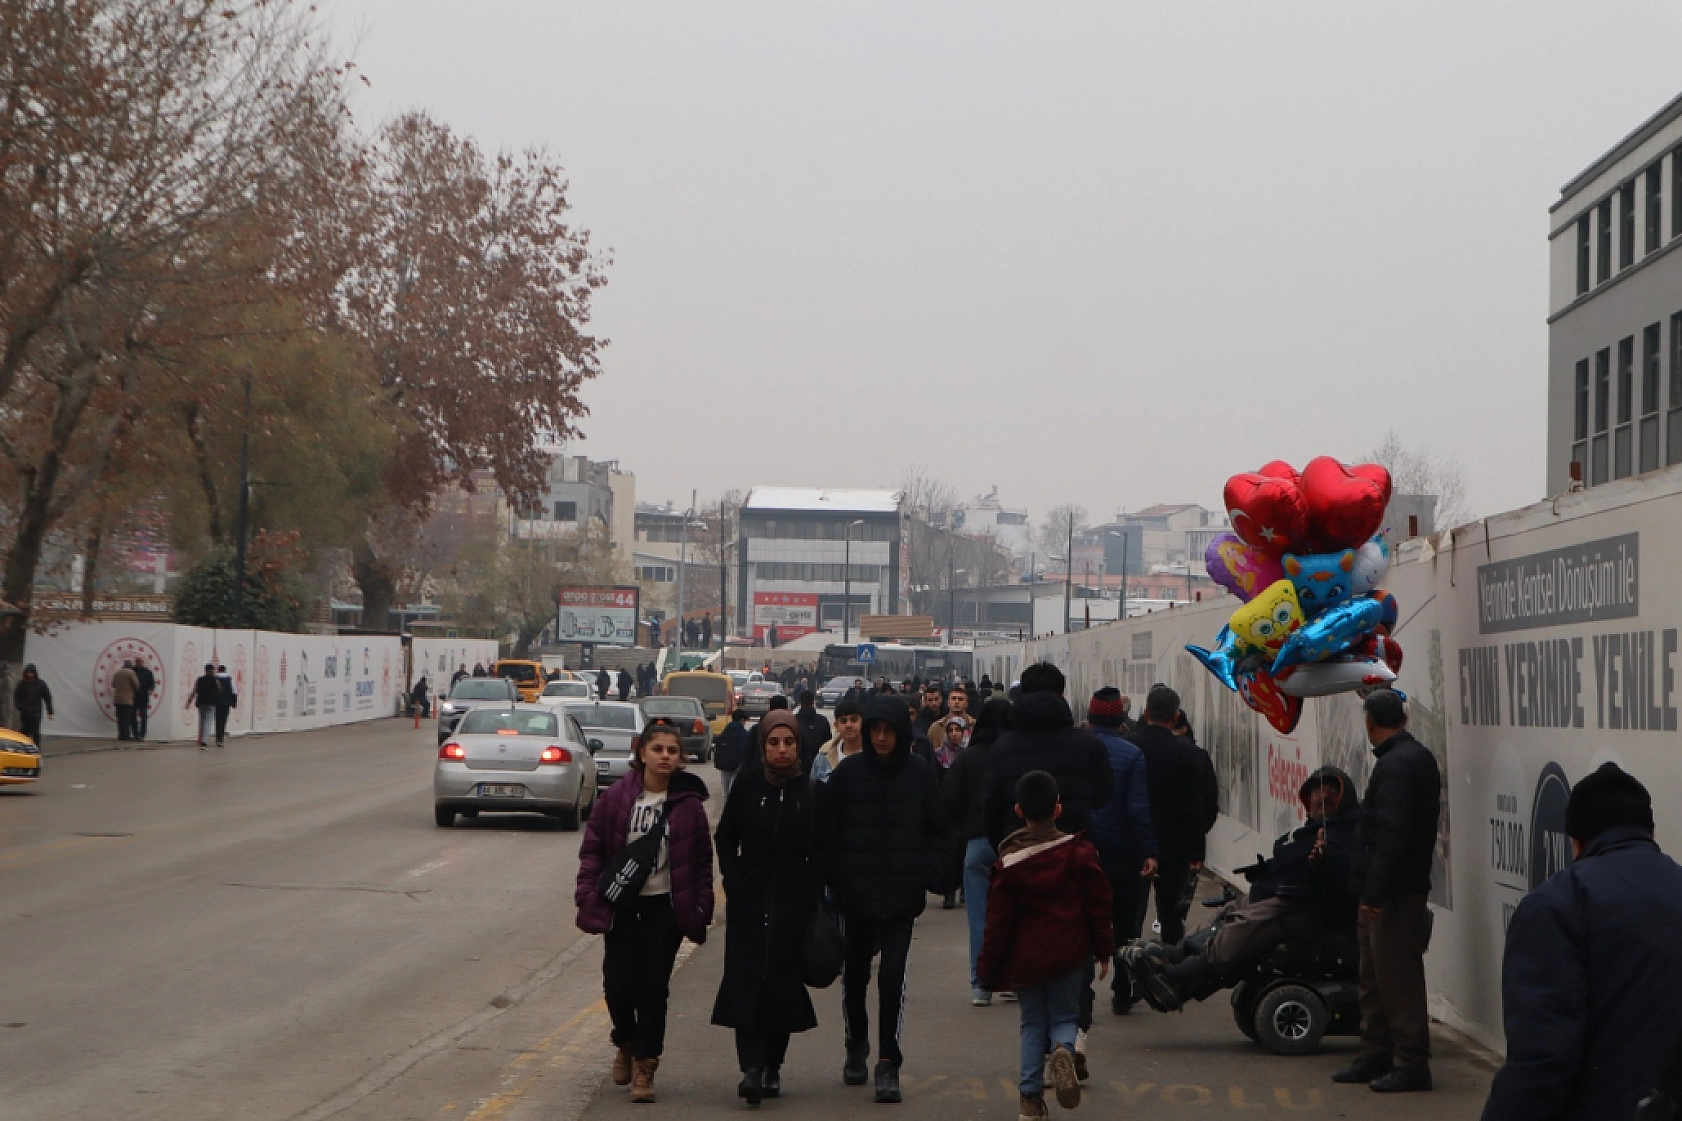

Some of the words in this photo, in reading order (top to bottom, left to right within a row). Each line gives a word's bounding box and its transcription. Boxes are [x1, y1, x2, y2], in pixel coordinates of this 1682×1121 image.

[1480, 570, 1516, 623] Yerinde
[1518, 558, 1557, 618] Kentsel
[1559, 553, 1616, 616] Dönüşüm
[1619, 543, 1635, 605] ile
[1505, 637, 1585, 728] YERİNDE
[1593, 628, 1678, 731] YENİLE
[1109, 1081, 1325, 1110] YOLU
